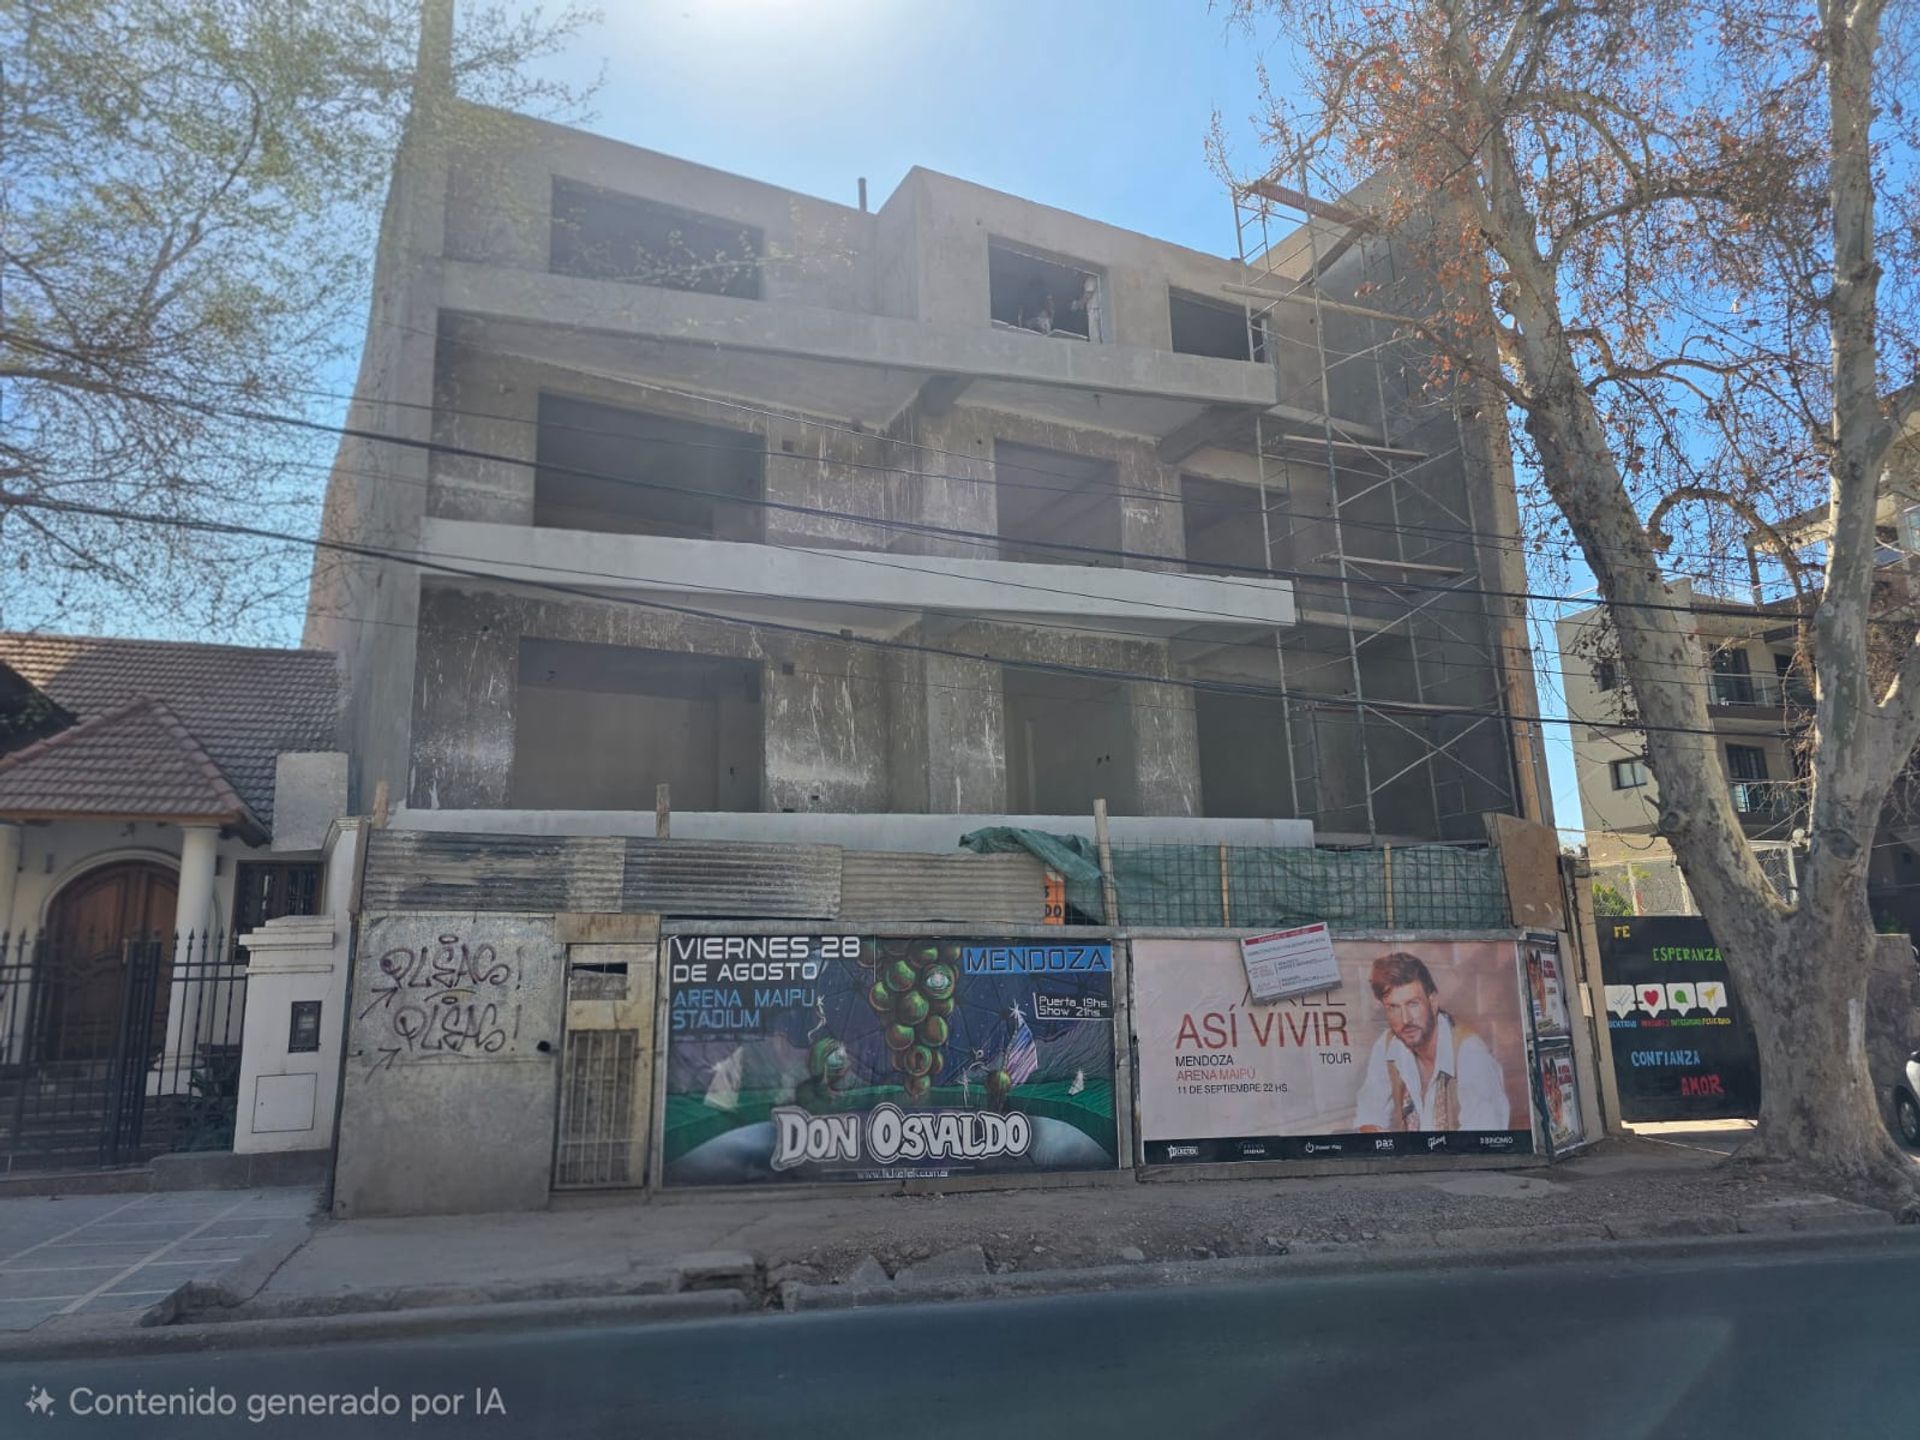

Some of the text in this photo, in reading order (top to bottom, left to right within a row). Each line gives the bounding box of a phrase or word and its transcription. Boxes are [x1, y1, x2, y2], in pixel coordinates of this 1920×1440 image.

[1614, 925, 1630, 938] FE
[675, 936, 860, 960] VIERNES 28
[1652, 946, 1722, 961] ESPERANZA
[967, 948, 1109, 972] MENDOZA
[673, 962, 818, 982] DE AGOSTO
[672, 988, 742, 1008] ARENA
[1039, 996, 1077, 1007] Puerta
[672, 1009, 760, 1029] STADIUM
[1039, 1006, 1070, 1016] Show
[1176, 1004, 1349, 1049] ASÍ VIVIR
[1175, 1055, 1234, 1067] MENDOZA
[1319, 1053, 1352, 1065] TOUR
[1631, 1050, 1701, 1067] CONFIANZA
[1176, 1069, 1217, 1082] ARENA
[1177, 1086, 1187, 1095] 11
[1189, 1085, 1202, 1095] DE
[1203, 1083, 1261, 1094] SEPTIEMBRE
[1262, 1083, 1274, 1093] 22
[1681, 1074, 1725, 1096] AMOR
[772, 1102, 1031, 1170] DON OSVALDO
